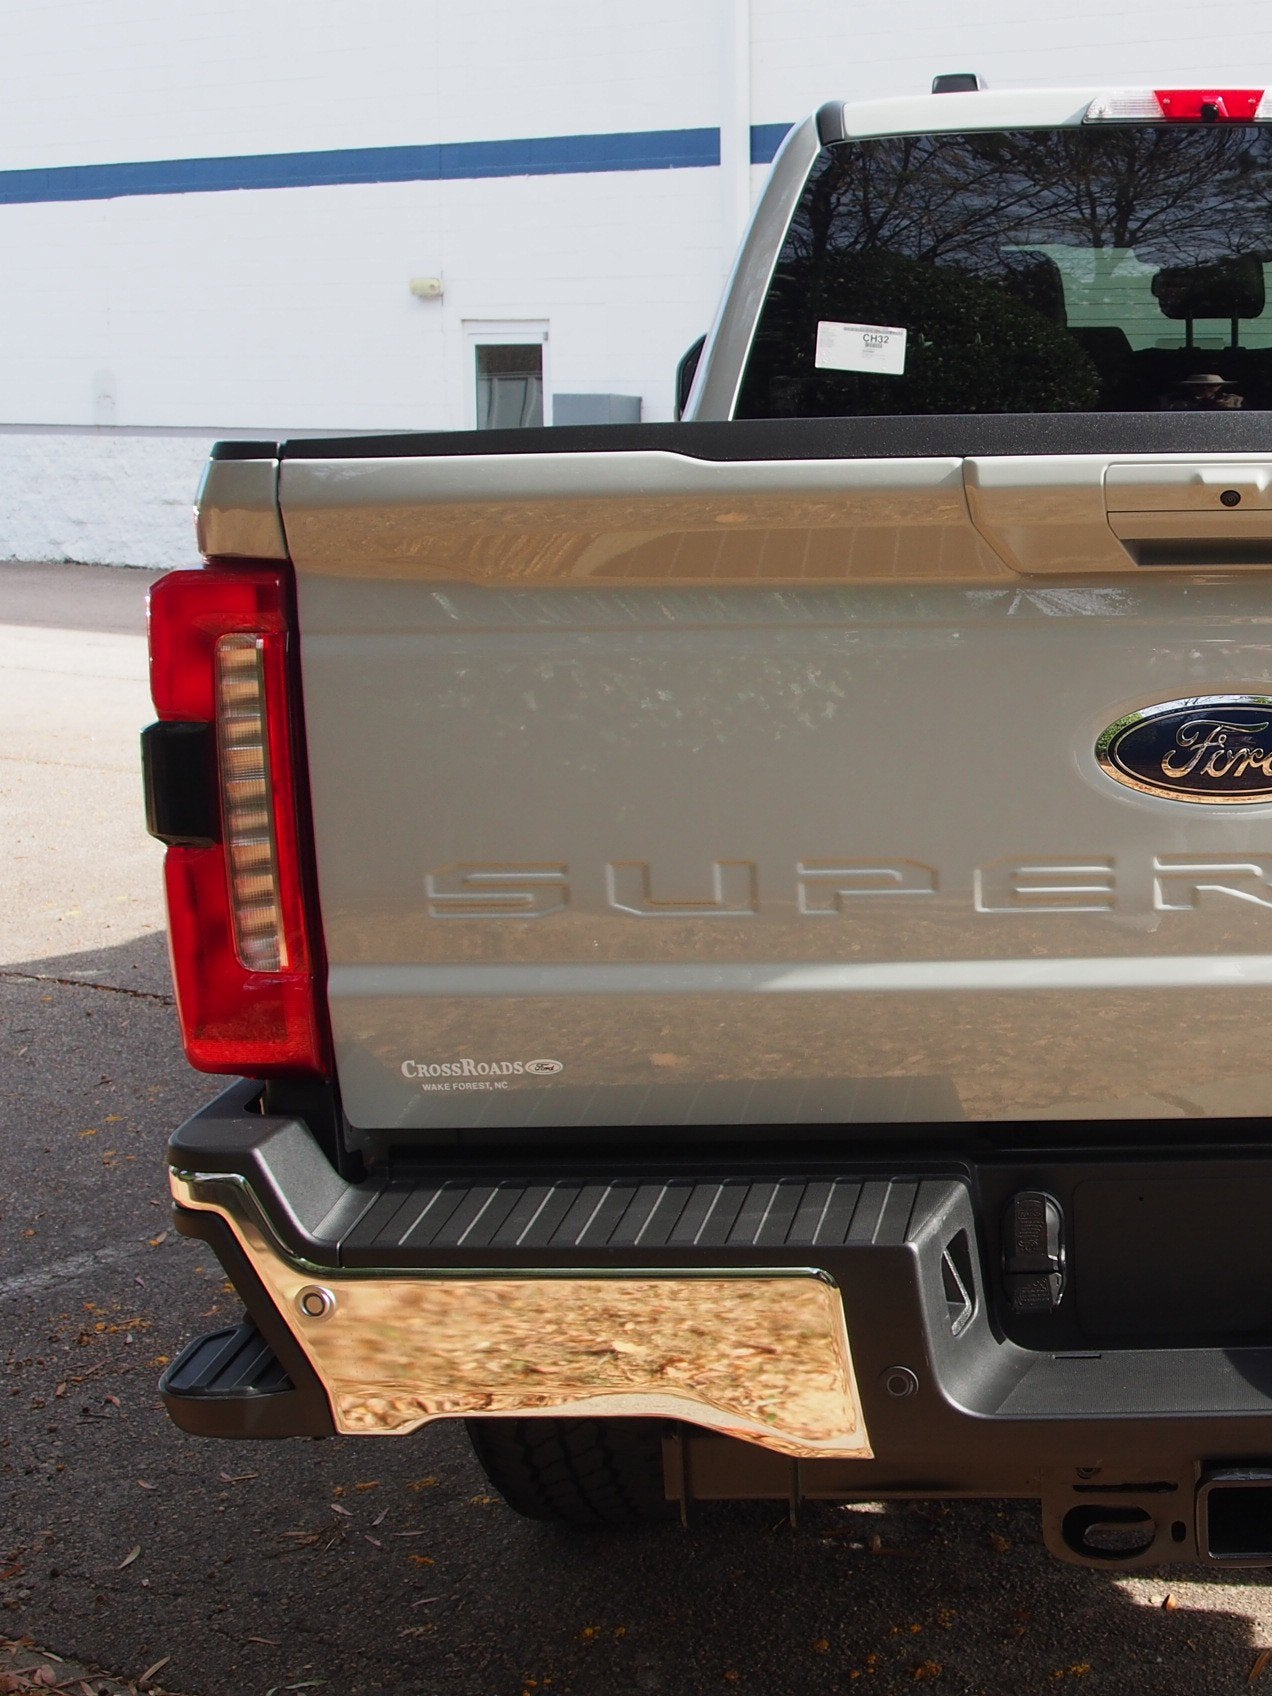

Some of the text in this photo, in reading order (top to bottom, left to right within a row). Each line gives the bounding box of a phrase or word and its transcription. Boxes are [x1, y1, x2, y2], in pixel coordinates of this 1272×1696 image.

[862, 333, 890, 344] CH32
[422, 1081, 508, 1091] WAKE FOREST, NC
